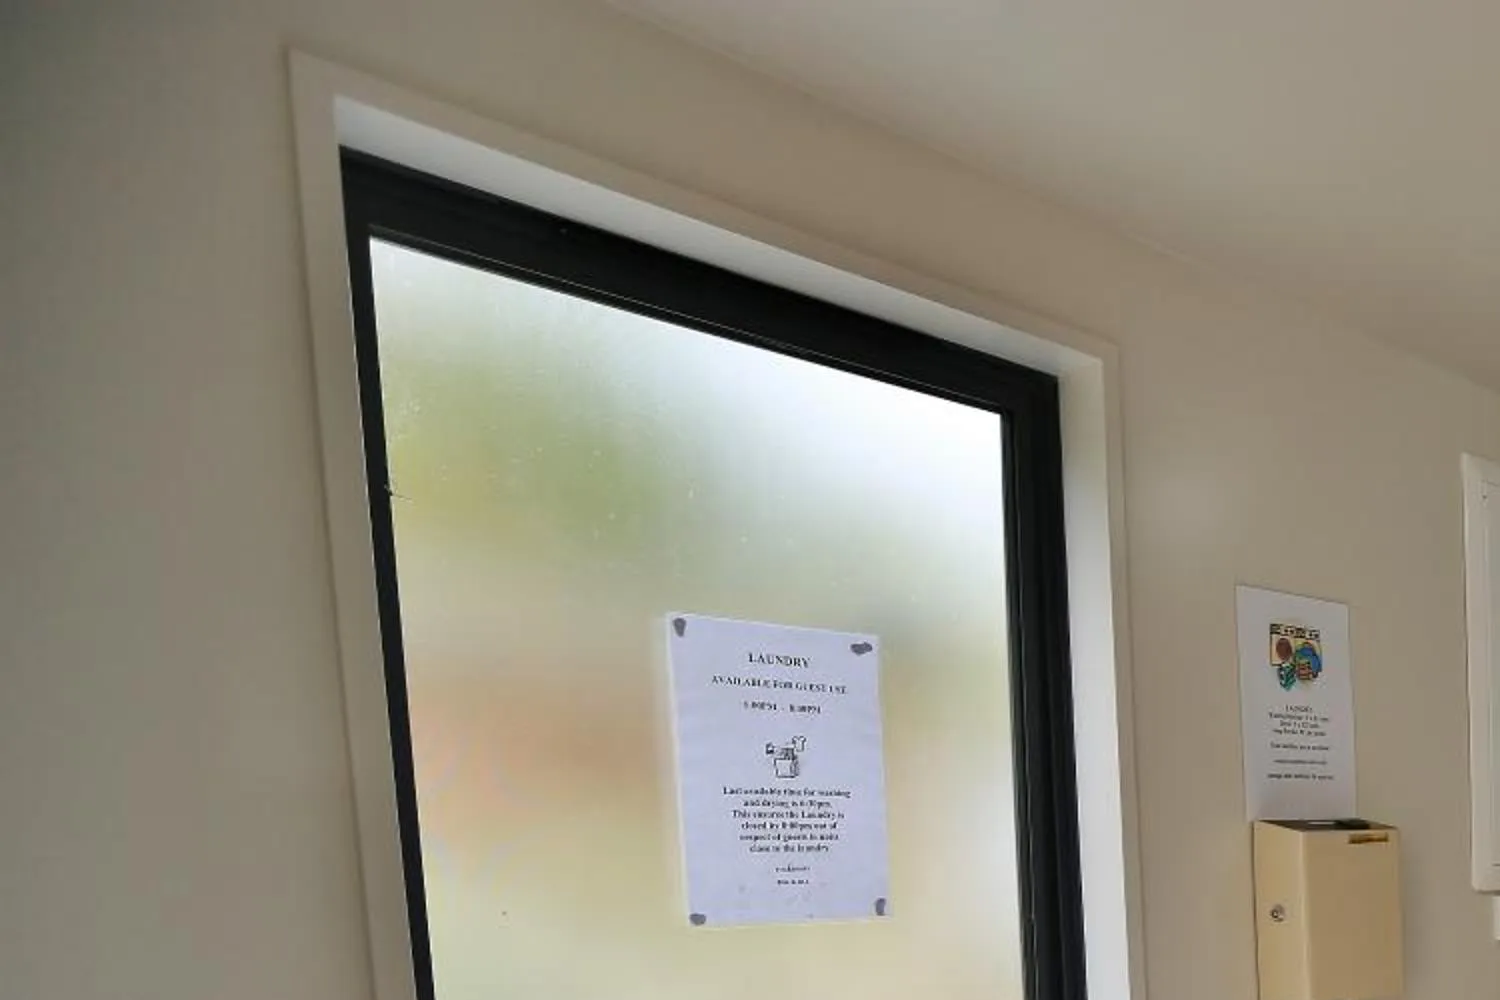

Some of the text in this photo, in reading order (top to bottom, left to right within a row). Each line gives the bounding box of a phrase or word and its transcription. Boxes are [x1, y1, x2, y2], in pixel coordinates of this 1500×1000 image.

[748, 652, 811, 668] LAUNDRY
[711, 675, 847, 695] AVAILABLE FOR GUEST USE
